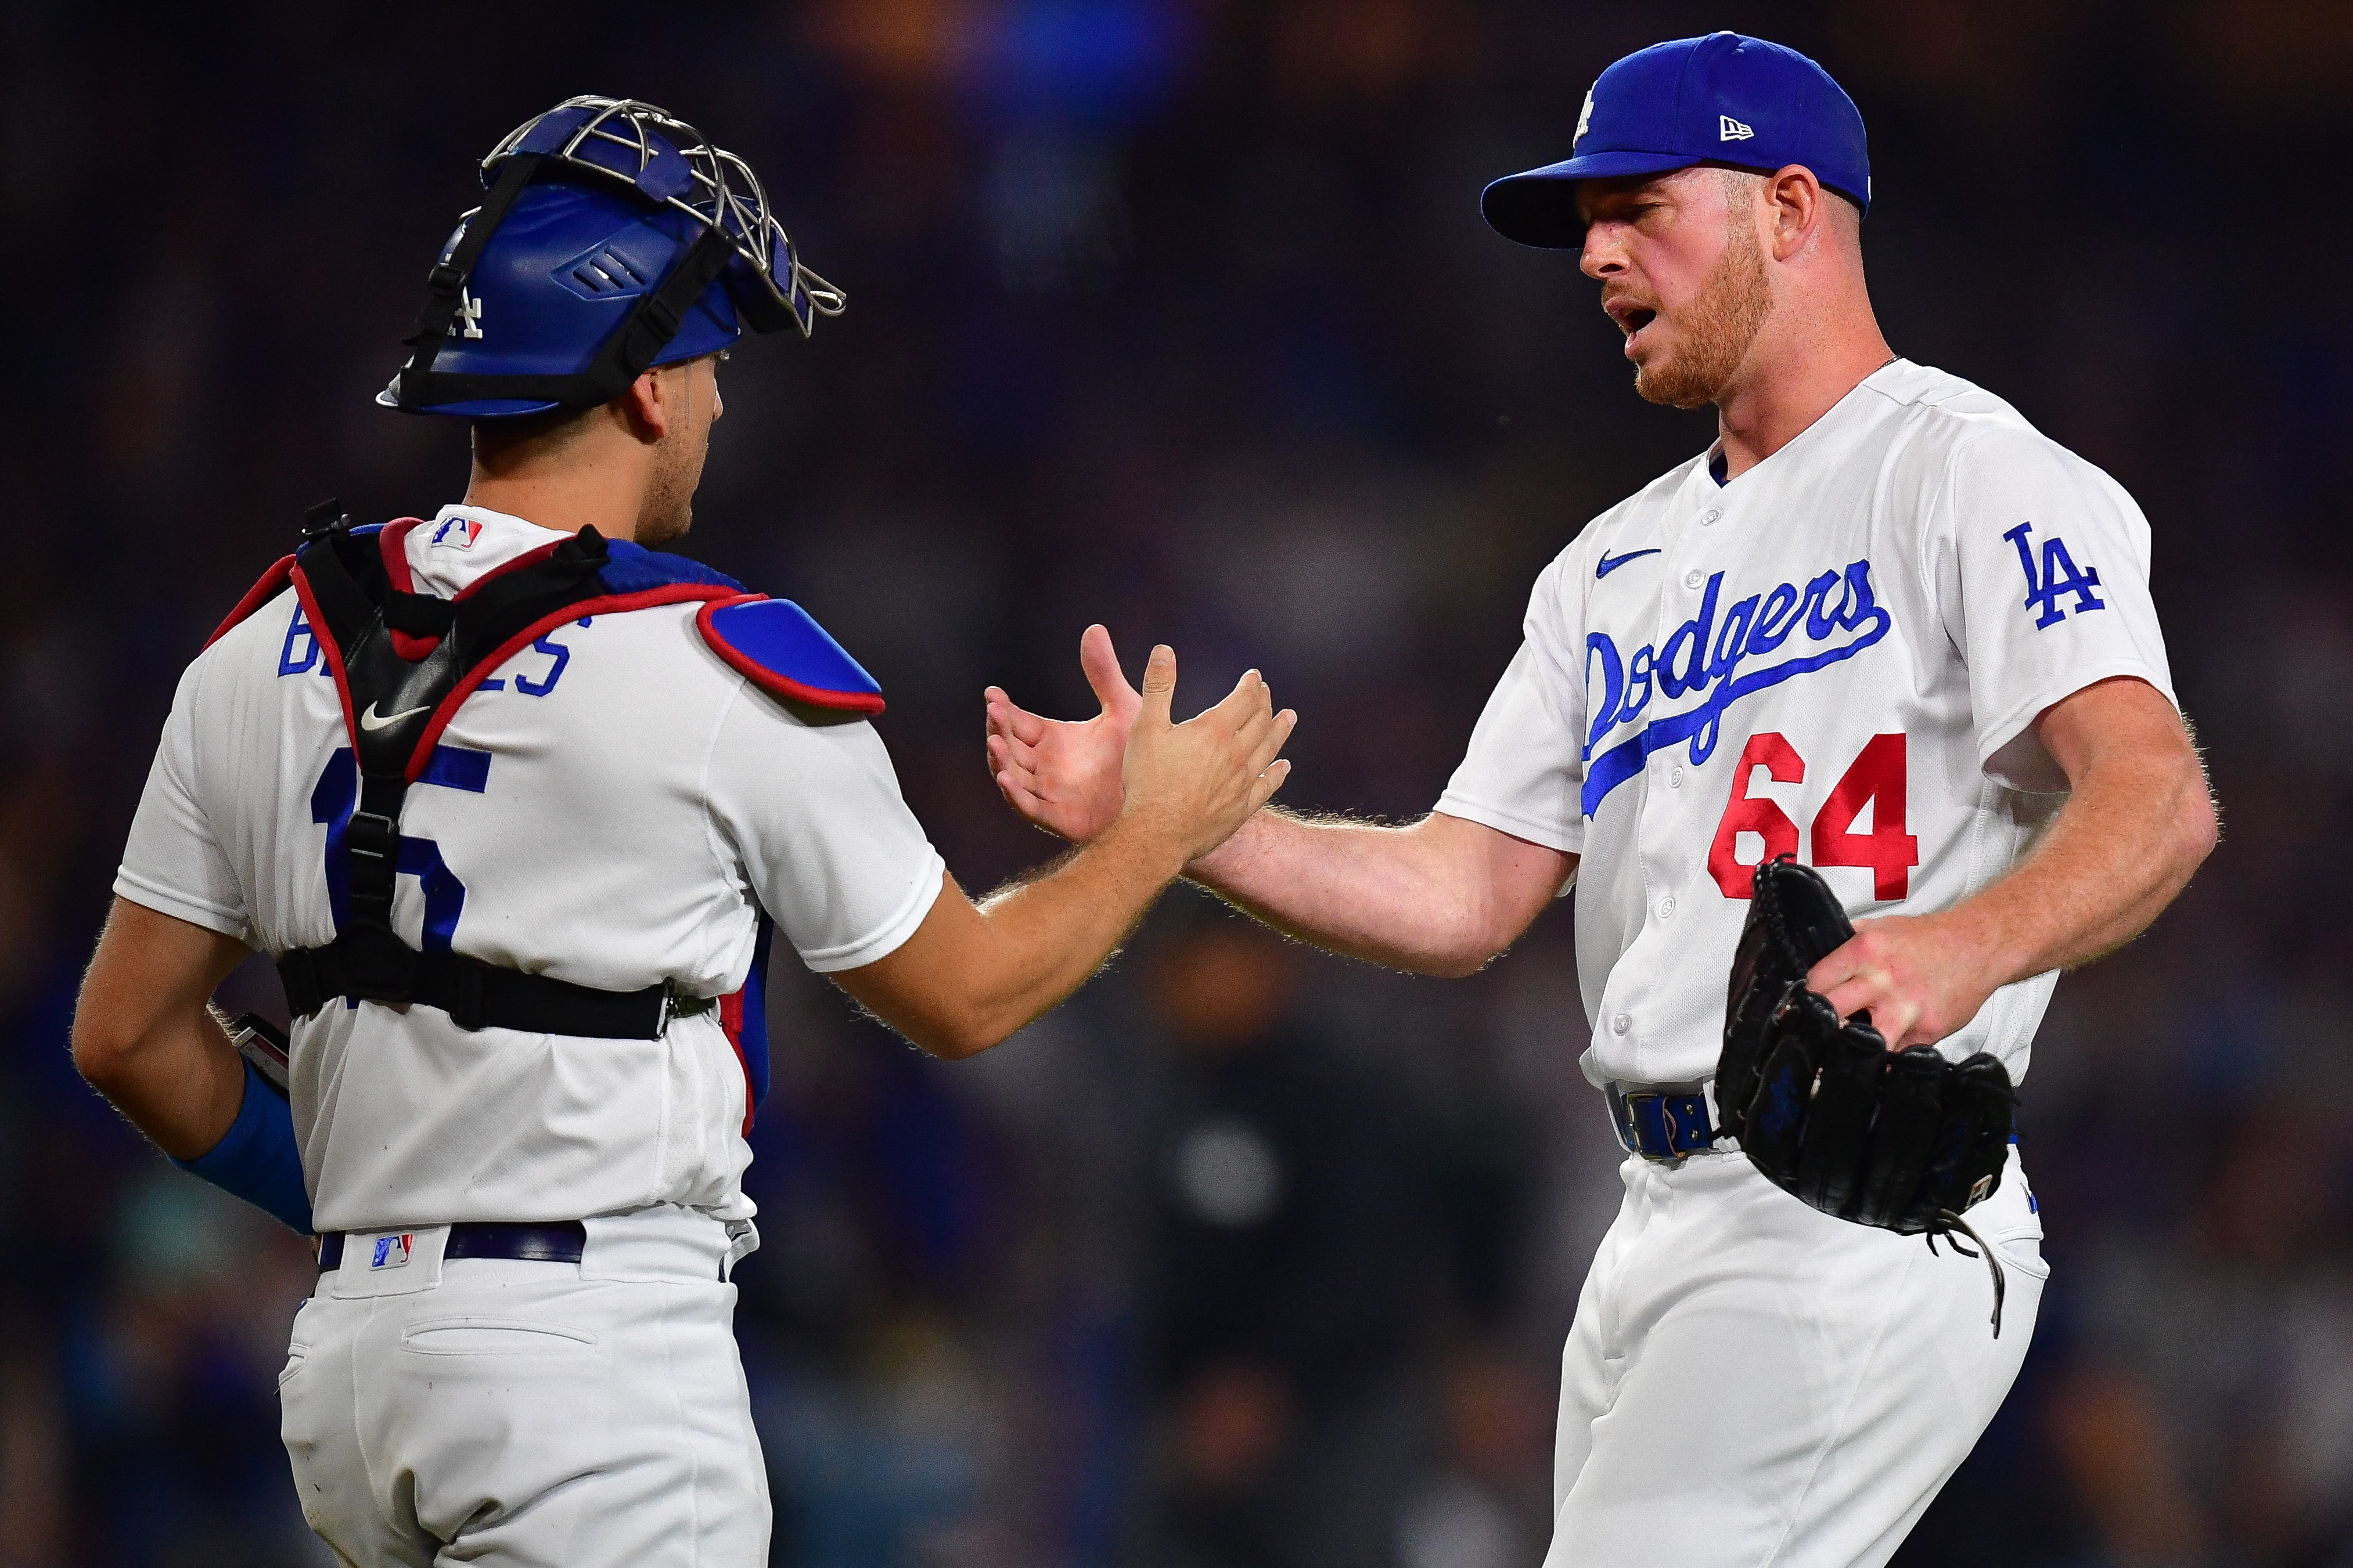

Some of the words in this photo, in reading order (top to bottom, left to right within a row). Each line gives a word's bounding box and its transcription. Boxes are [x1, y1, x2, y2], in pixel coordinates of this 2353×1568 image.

[2003, 521, 2105, 630] LA
[1581, 559, 1891, 766] Dodgers
[1708, 732, 1919, 900] 64
